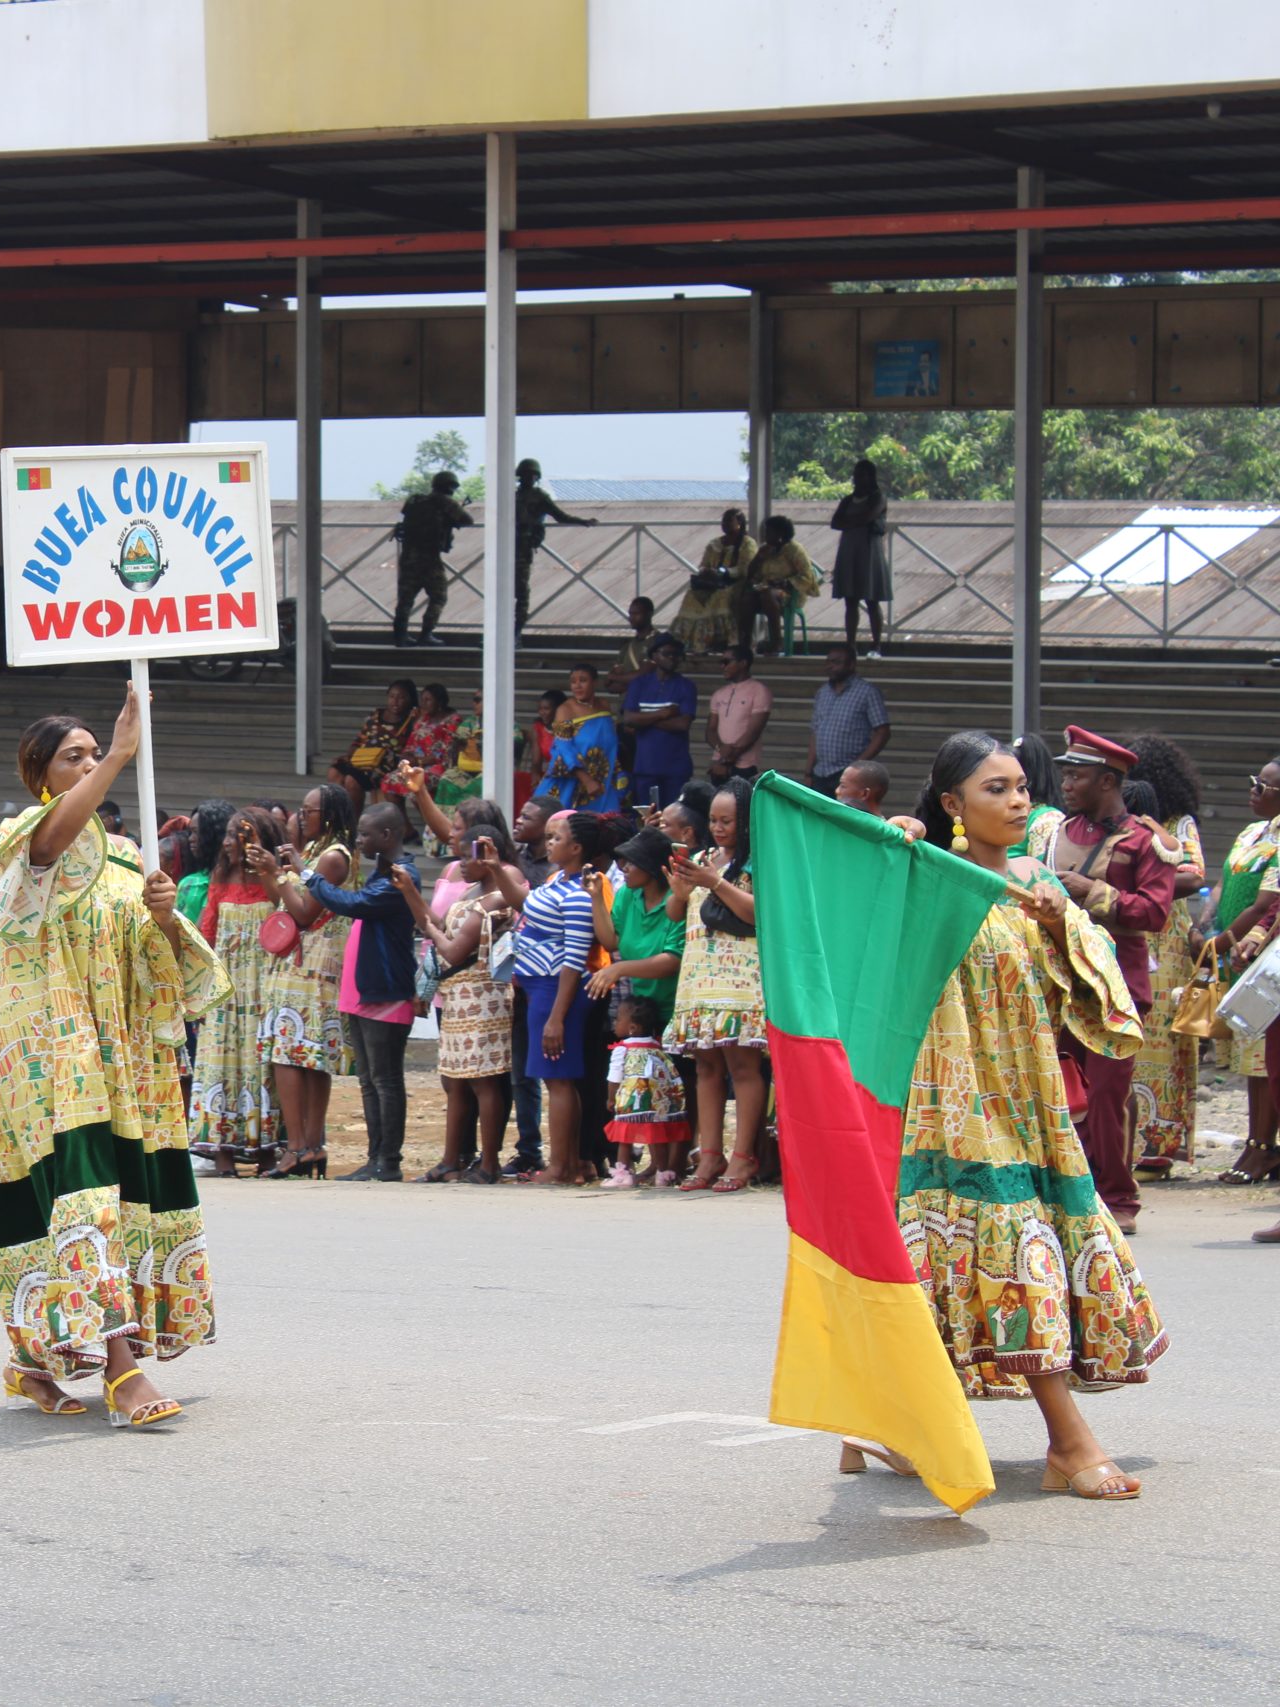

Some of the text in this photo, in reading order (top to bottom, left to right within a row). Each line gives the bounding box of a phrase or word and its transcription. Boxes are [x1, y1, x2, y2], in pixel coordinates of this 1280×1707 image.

[22, 466, 253, 594] BUEA COUNCIL
[23, 592, 258, 641] WOMEN
